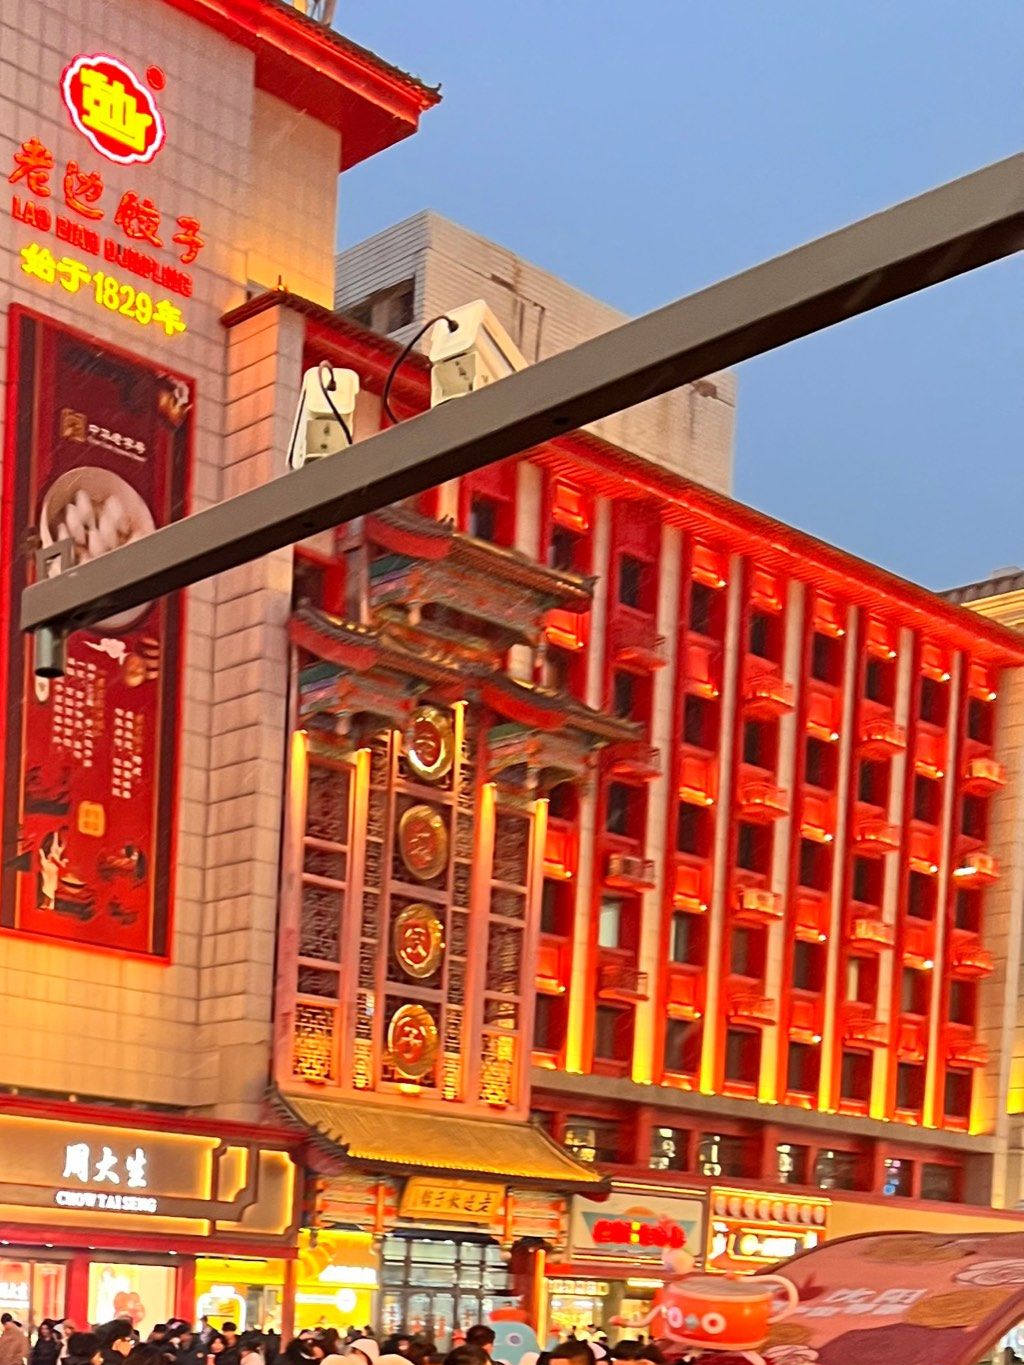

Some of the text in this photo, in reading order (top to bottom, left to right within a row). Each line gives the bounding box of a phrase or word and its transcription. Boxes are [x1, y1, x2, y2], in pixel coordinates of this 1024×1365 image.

[11, 194, 52, 232] LAO
[19, 242, 188, 337] 始于1829年
[62, 1142, 148, 1188] 周大生
